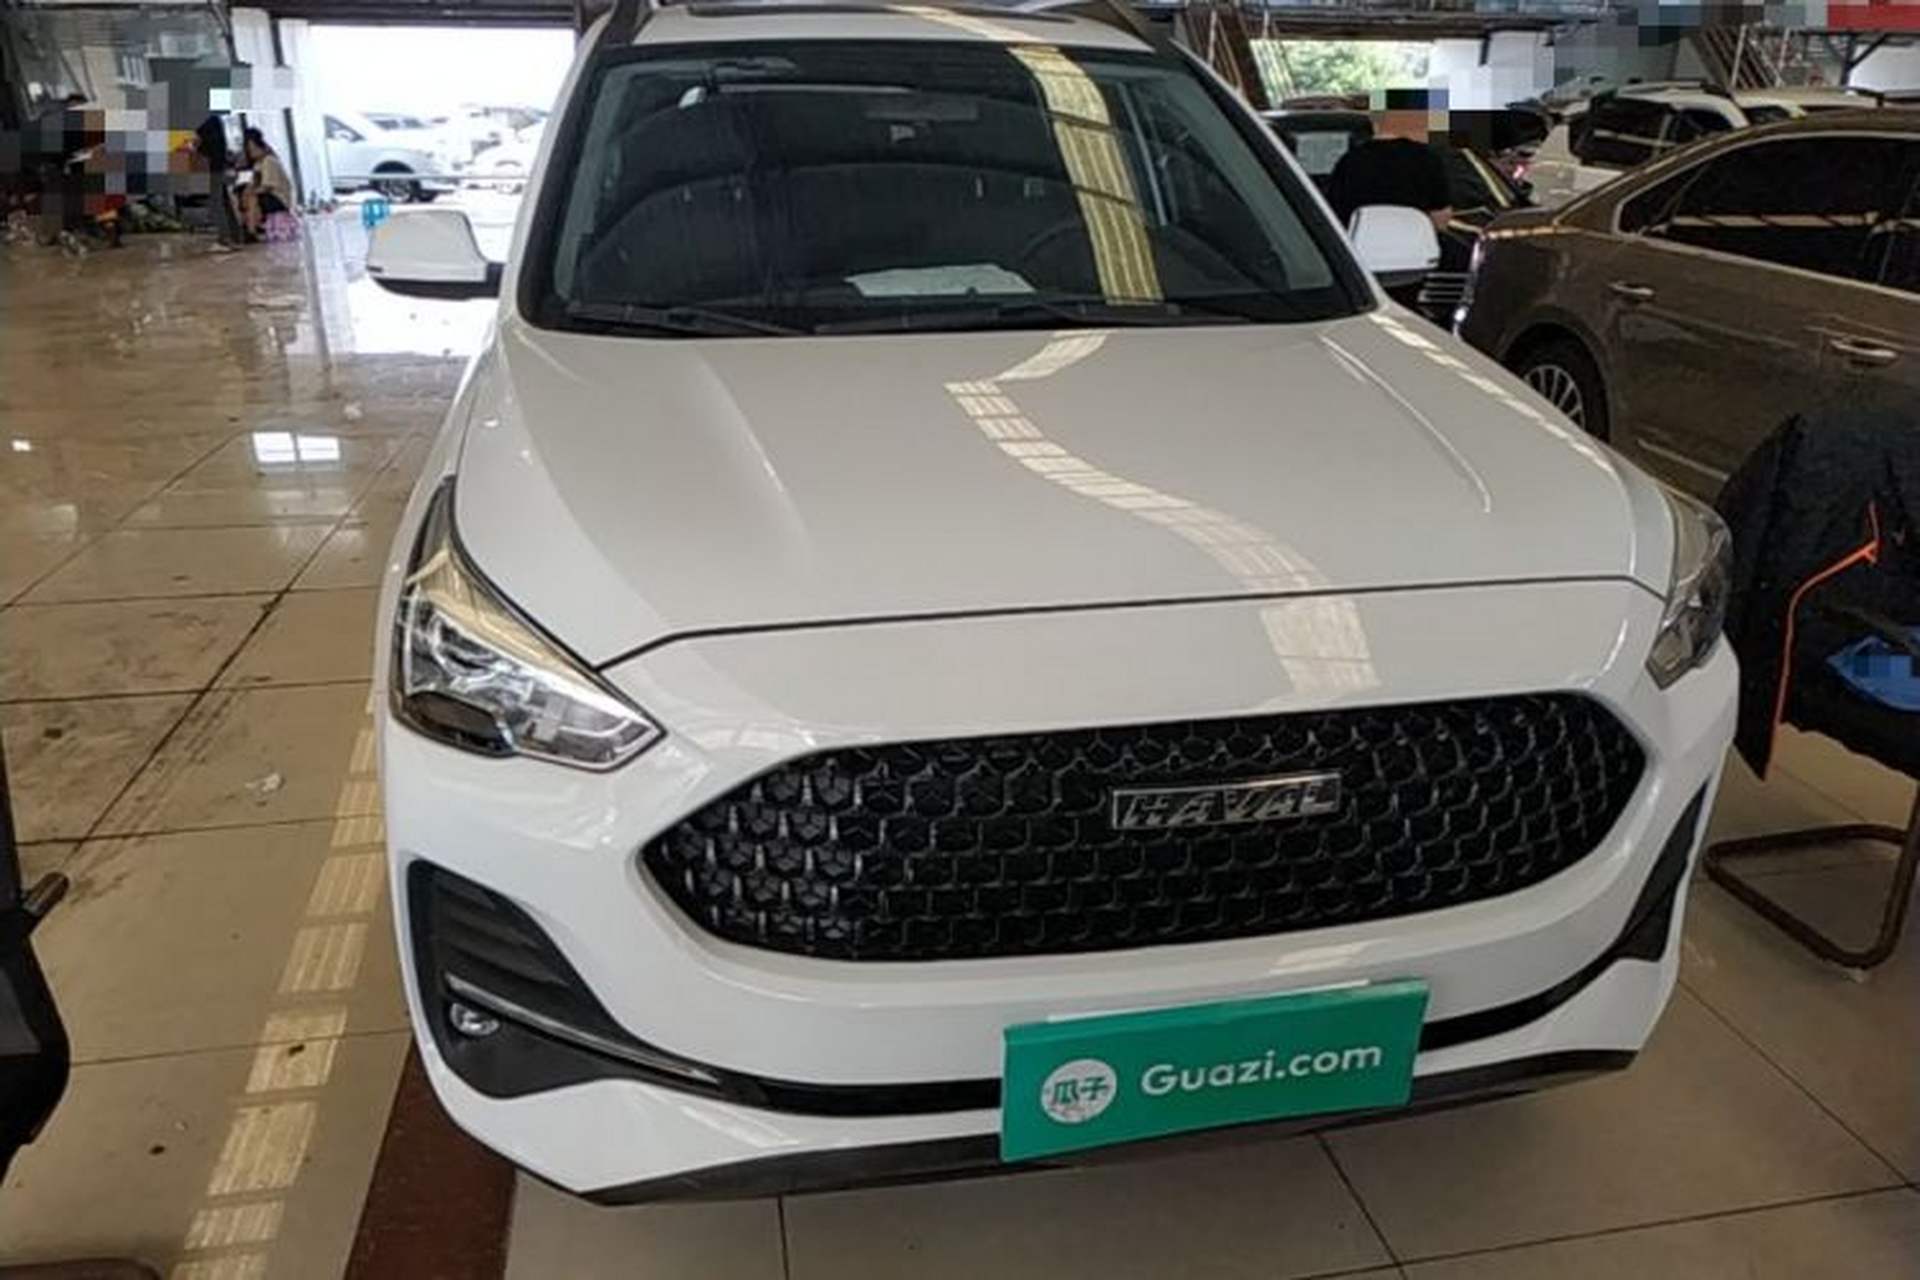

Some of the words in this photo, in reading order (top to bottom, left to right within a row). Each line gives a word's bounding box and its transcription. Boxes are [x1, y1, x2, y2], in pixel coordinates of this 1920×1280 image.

[1118, 780, 1337, 827] HAVAL
[1053, 1076, 1109, 1105] 瓜子
[1141, 1045, 1382, 1095] Guazi.com
